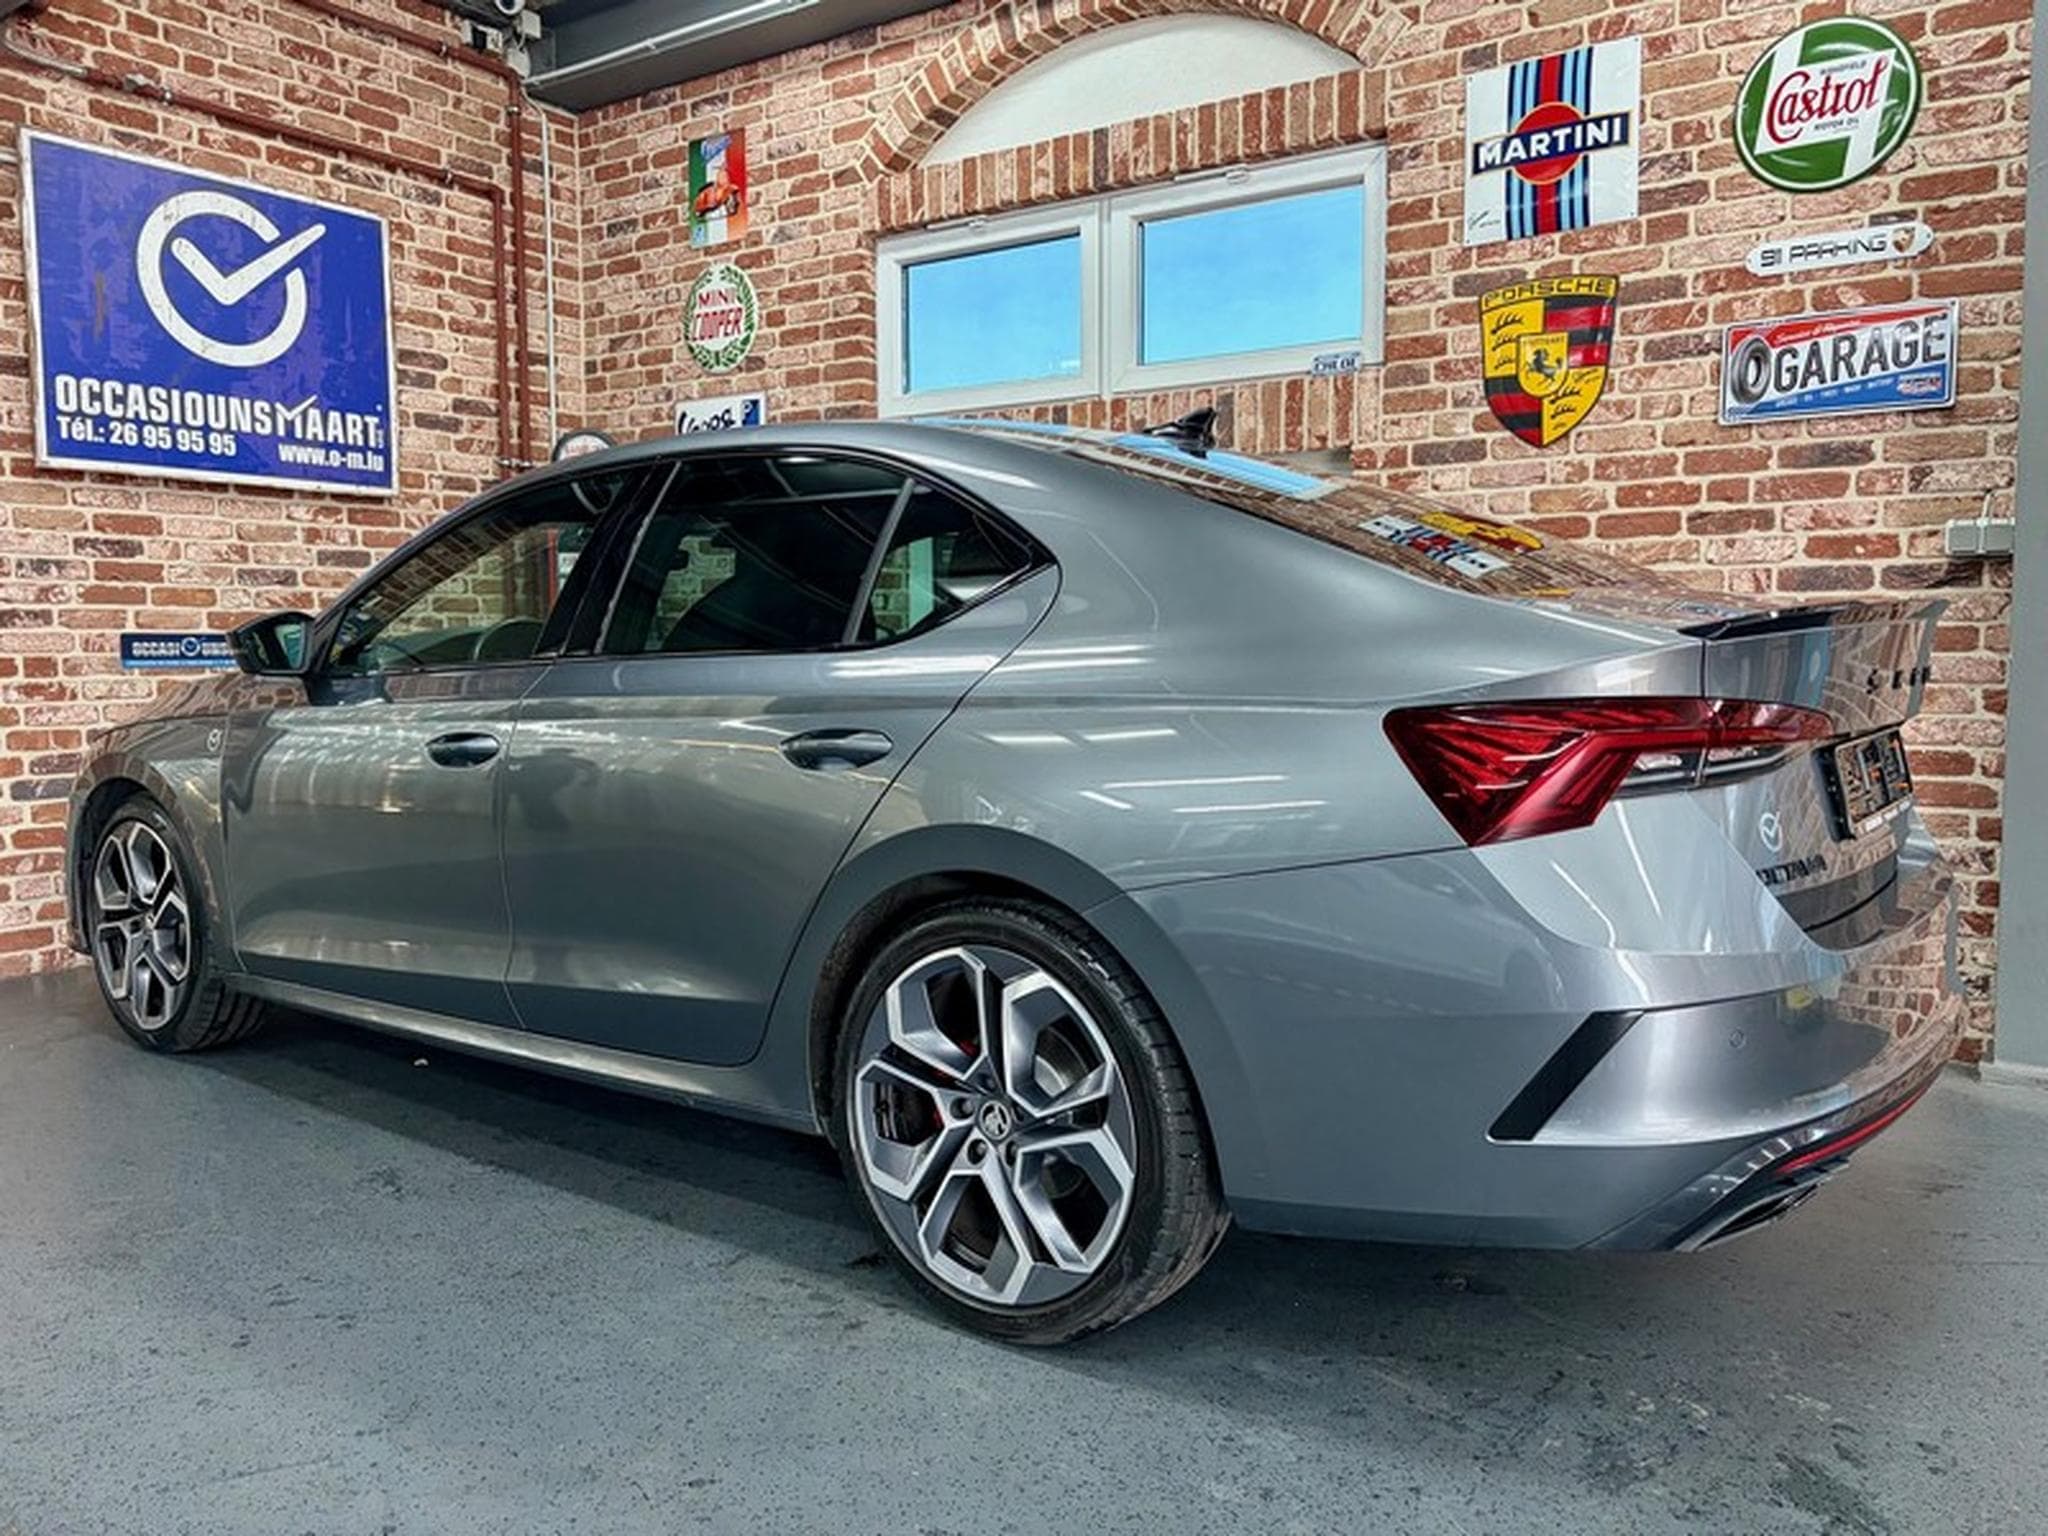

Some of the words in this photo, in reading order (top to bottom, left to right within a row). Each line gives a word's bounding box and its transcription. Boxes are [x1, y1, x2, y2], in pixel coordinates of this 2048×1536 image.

[1765, 55, 1889, 144] Castrol
[1478, 117, 1622, 170] MARTINI
[1789, 234, 1887, 263] PARKING
[698, 288, 737, 306] MINI
[1484, 279, 1612, 307] PORSCHE
[692, 307, 743, 342] COOPER
[1774, 312, 1948, 393] GARAGE
[57, 415, 105, 442] Tél.:
[109, 422, 139, 447] 26
[143, 425, 172, 449] 95
[177, 429, 205, 453] 95
[209, 433, 237, 457] 95
[278, 444, 384, 472] www.o-m.lu
